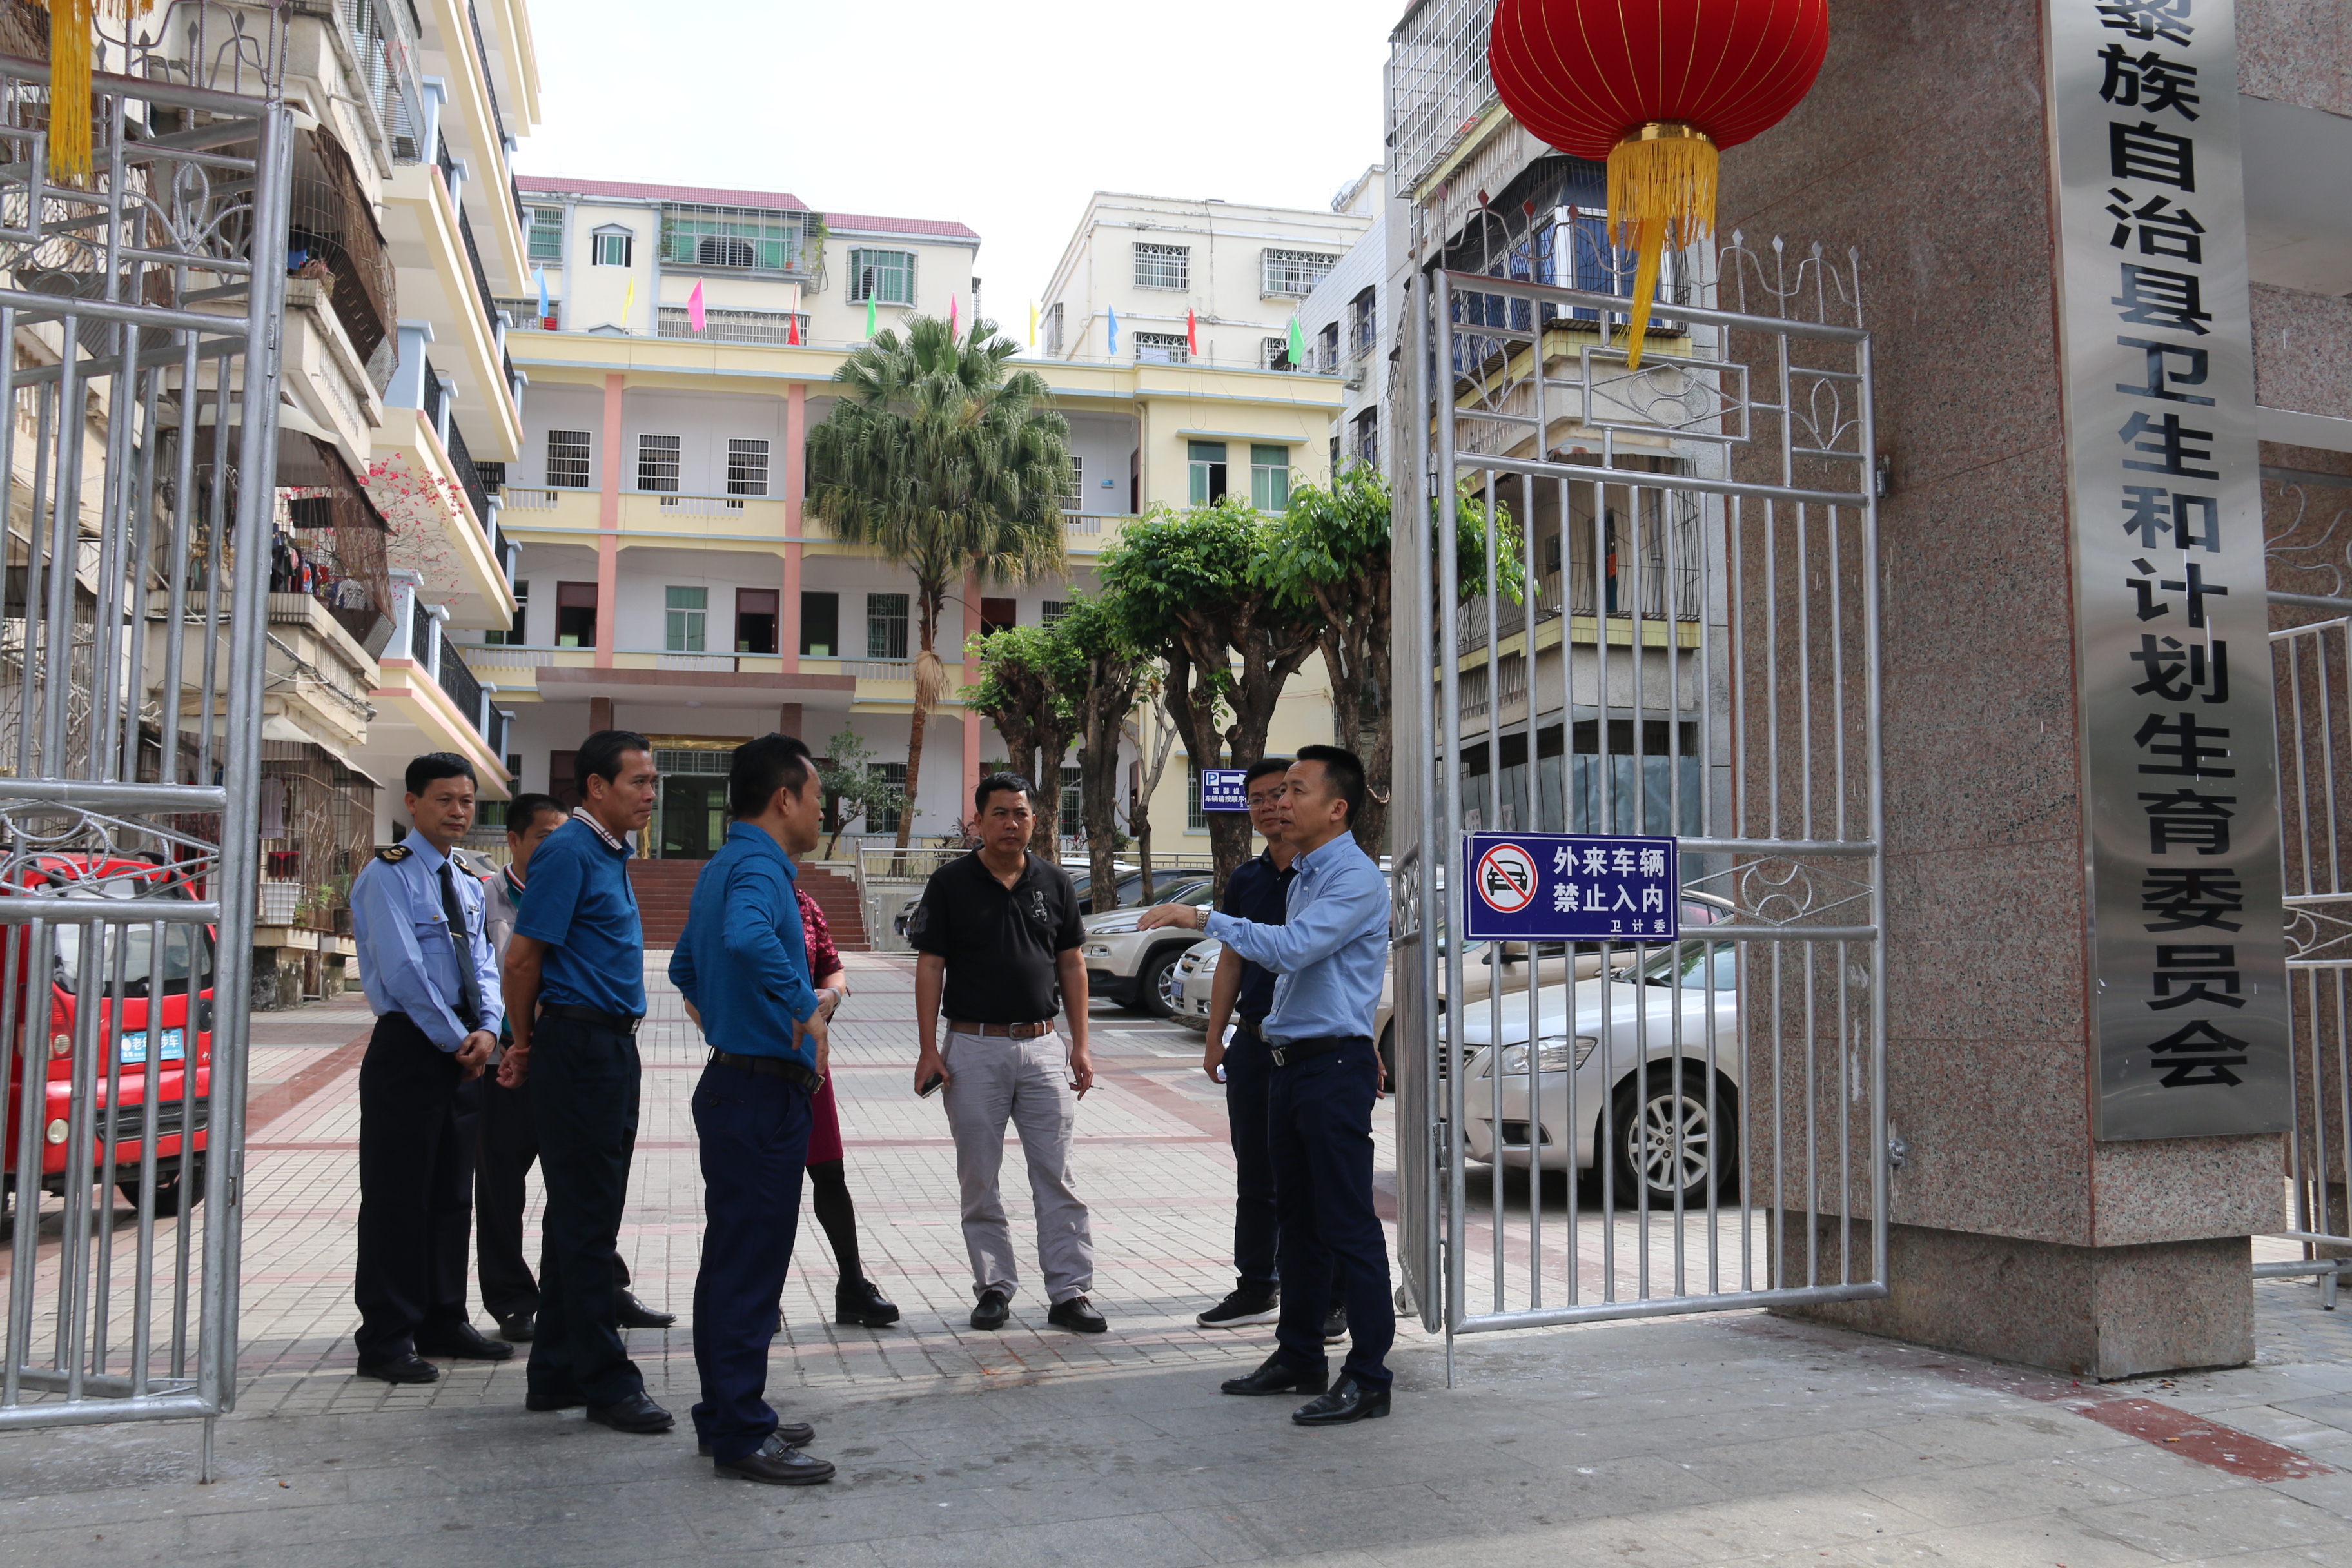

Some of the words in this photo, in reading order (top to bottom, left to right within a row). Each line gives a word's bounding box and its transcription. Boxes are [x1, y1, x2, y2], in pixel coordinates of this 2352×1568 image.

[2095, 0, 2250, 1088] 黎族自治县卫生和计划生育委员会
[1208, 773, 1217, 785] P
[1553, 845, 1665, 877] 外来车辆
[1553, 882, 1664, 913] 禁止入内
[1611, 919, 1665, 934] 卫计委
